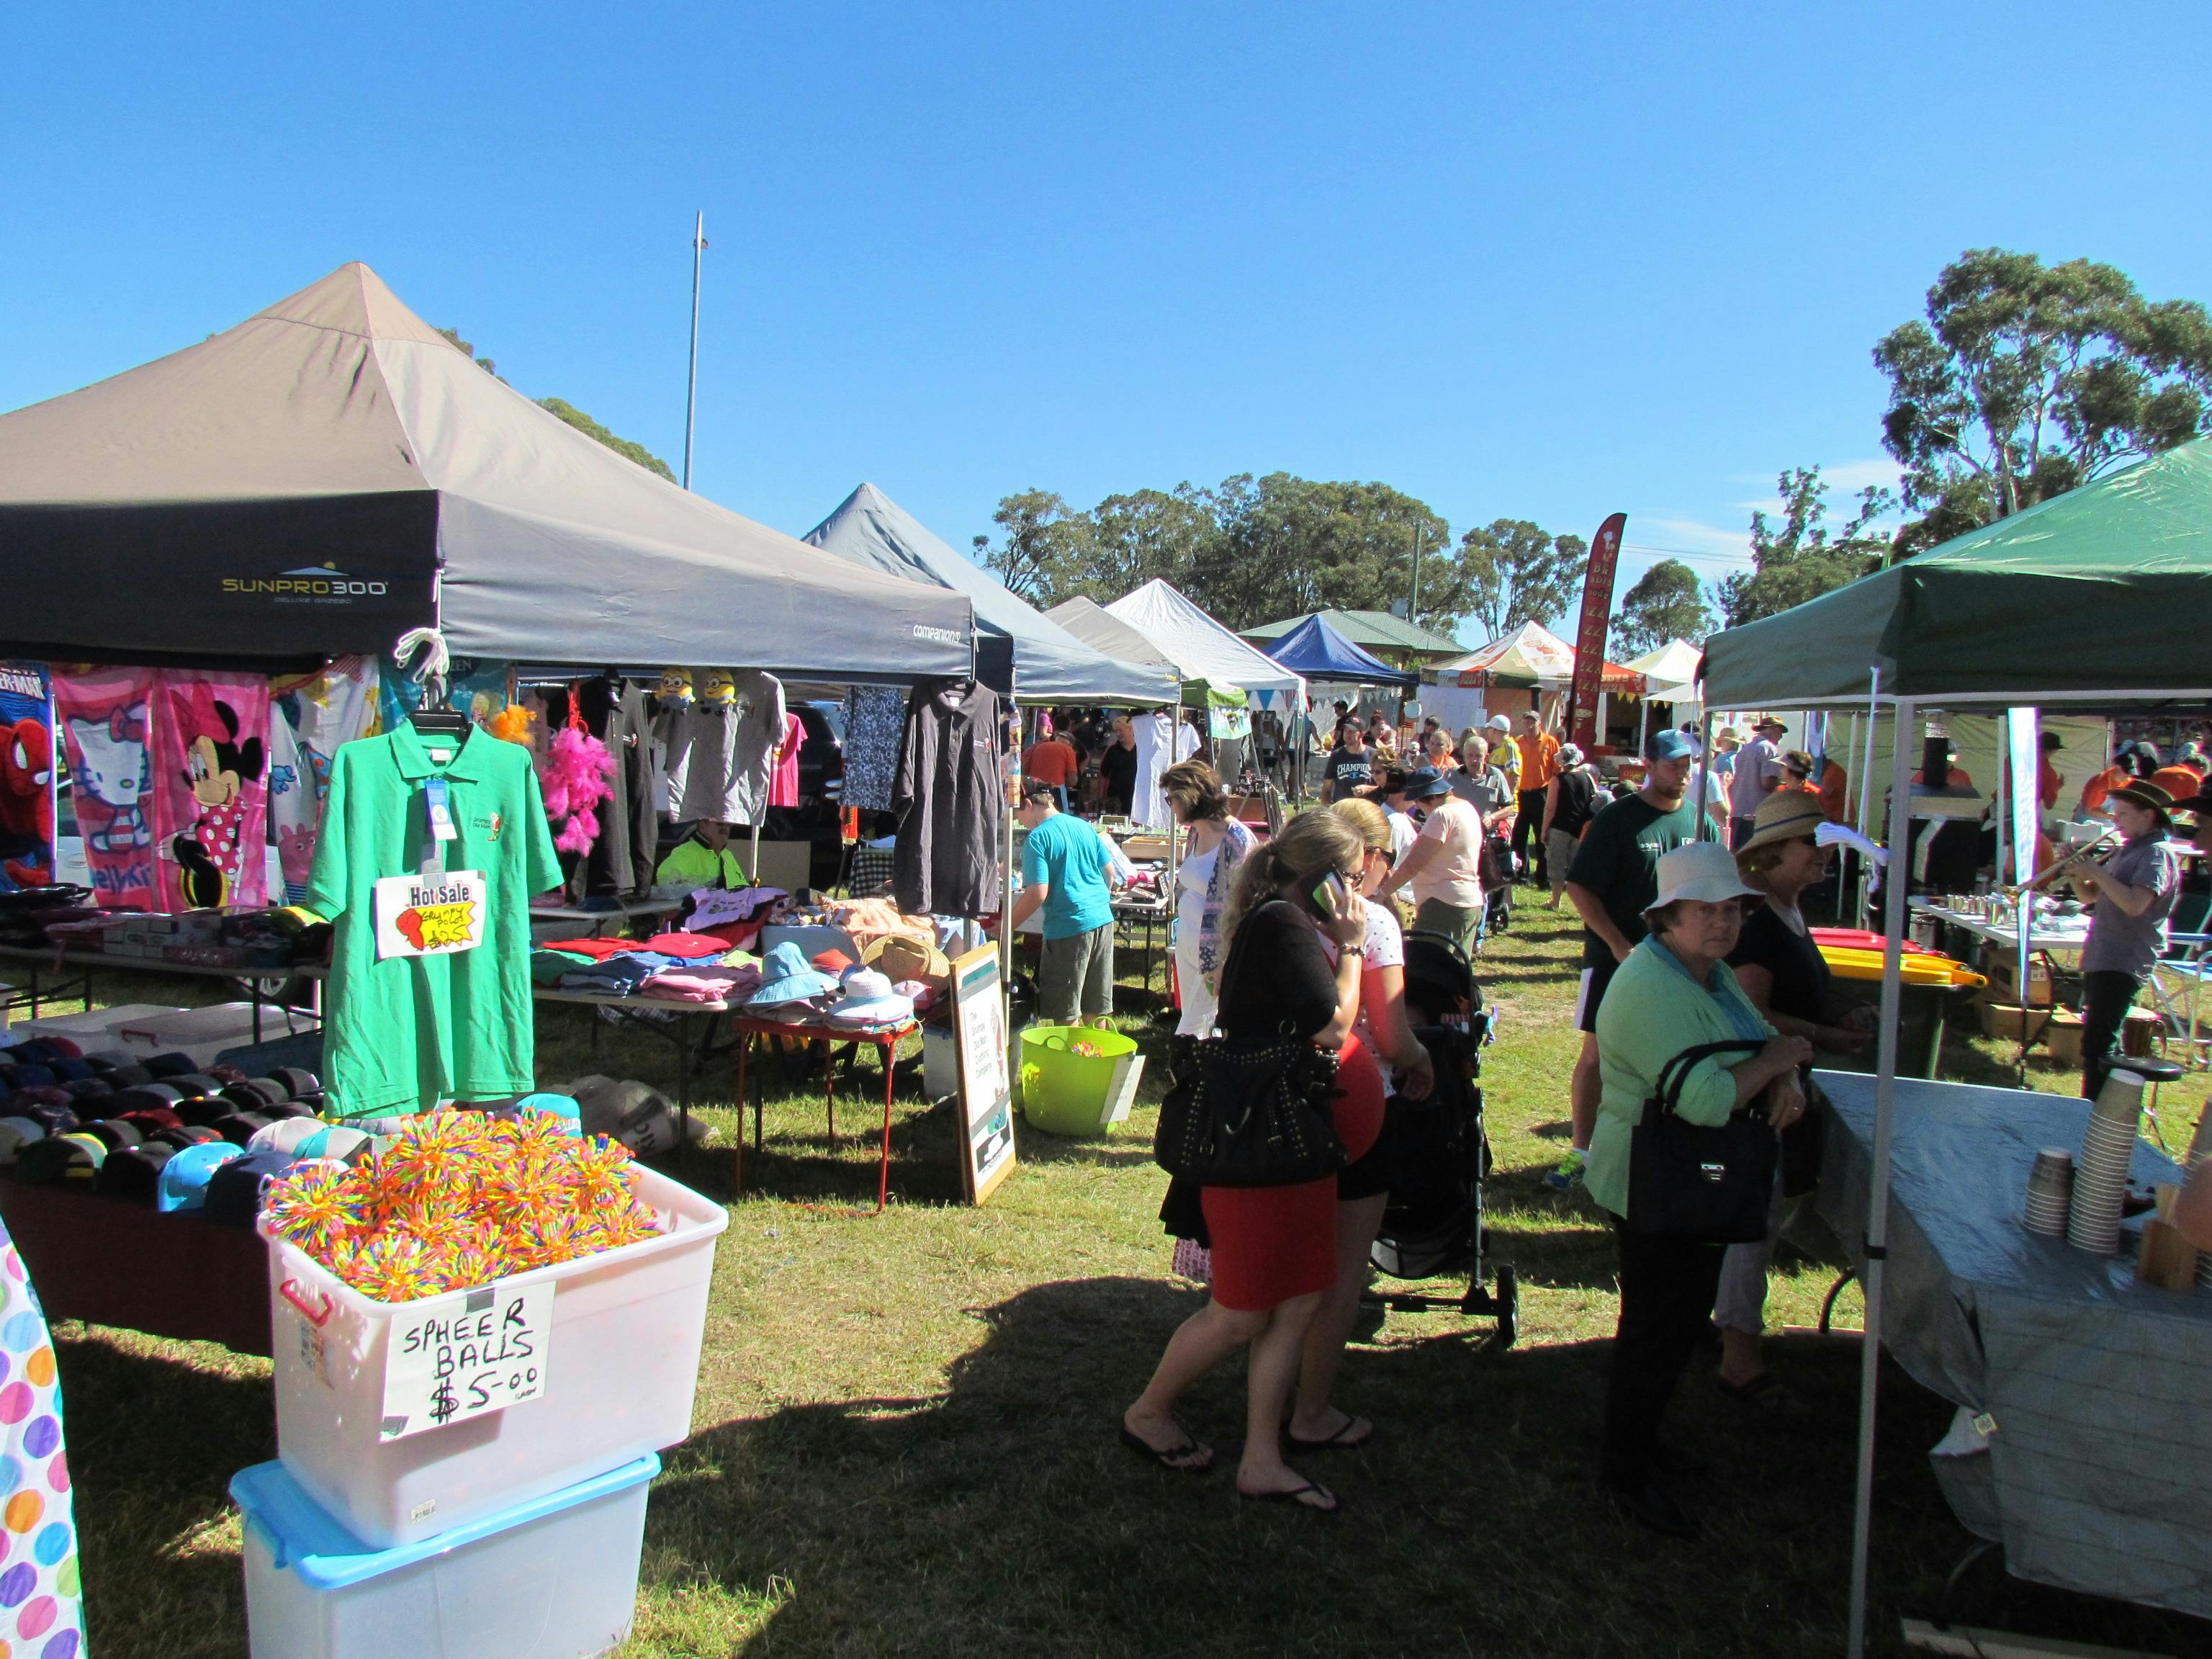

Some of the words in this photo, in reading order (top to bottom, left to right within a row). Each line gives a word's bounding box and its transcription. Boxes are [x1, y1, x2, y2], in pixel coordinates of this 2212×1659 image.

[913, 624, 956, 642] companion
[410, 886, 436, 907] Hot
[439, 883, 469, 904] Sale
[403, 1297, 526, 1354] SPHEER
[433, 1330, 534, 1380] BALLS
